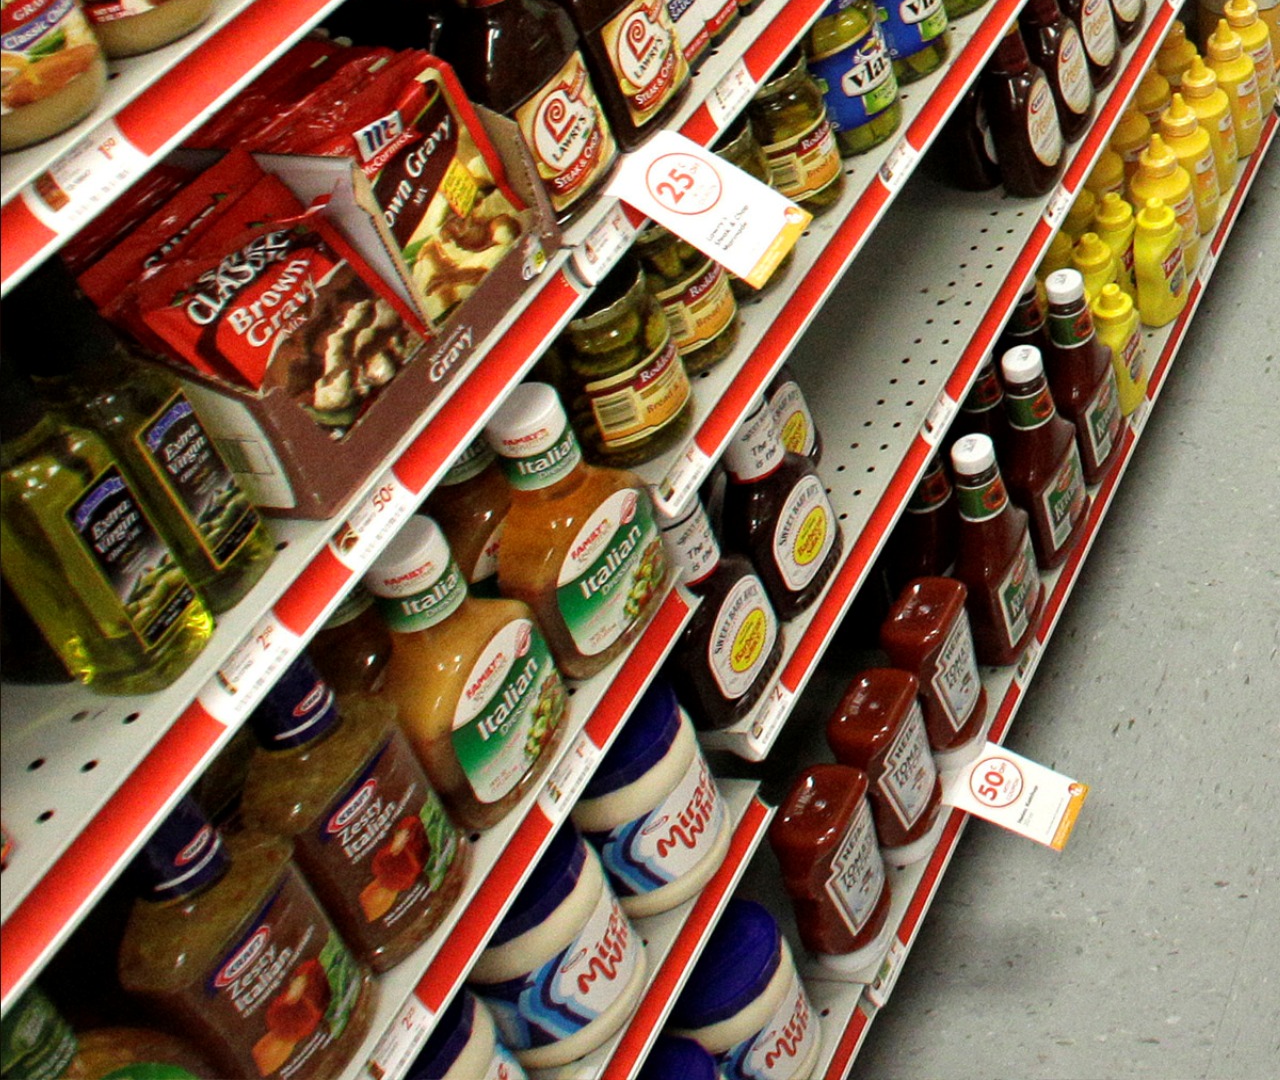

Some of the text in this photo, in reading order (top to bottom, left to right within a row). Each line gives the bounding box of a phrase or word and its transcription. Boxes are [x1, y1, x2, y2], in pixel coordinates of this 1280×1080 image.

[1, 19, 47, 50] Classic
[634, 34, 664, 80] LAWRY'S
[360, 133, 413, 176] McCormick
[404, 115, 451, 188] Gravy
[553, 115, 587, 163] LAWRY'S
[656, 165, 695, 203] 25
[227, 258, 309, 336] Brown
[245, 275, 326, 347] Gravy
[429, 327, 474, 383] Gravy
[581, 524, 643, 601] Italian
[715, 620, 730, 654] SWEET
[477, 657, 538, 740] Italian
[978, 771, 1004, 801] 50
[337, 799, 382, 847] Zesty
[345, 803, 396, 857] Italian
[227, 946, 278, 1000] Zesty
[234, 949, 293, 1012] Italian
